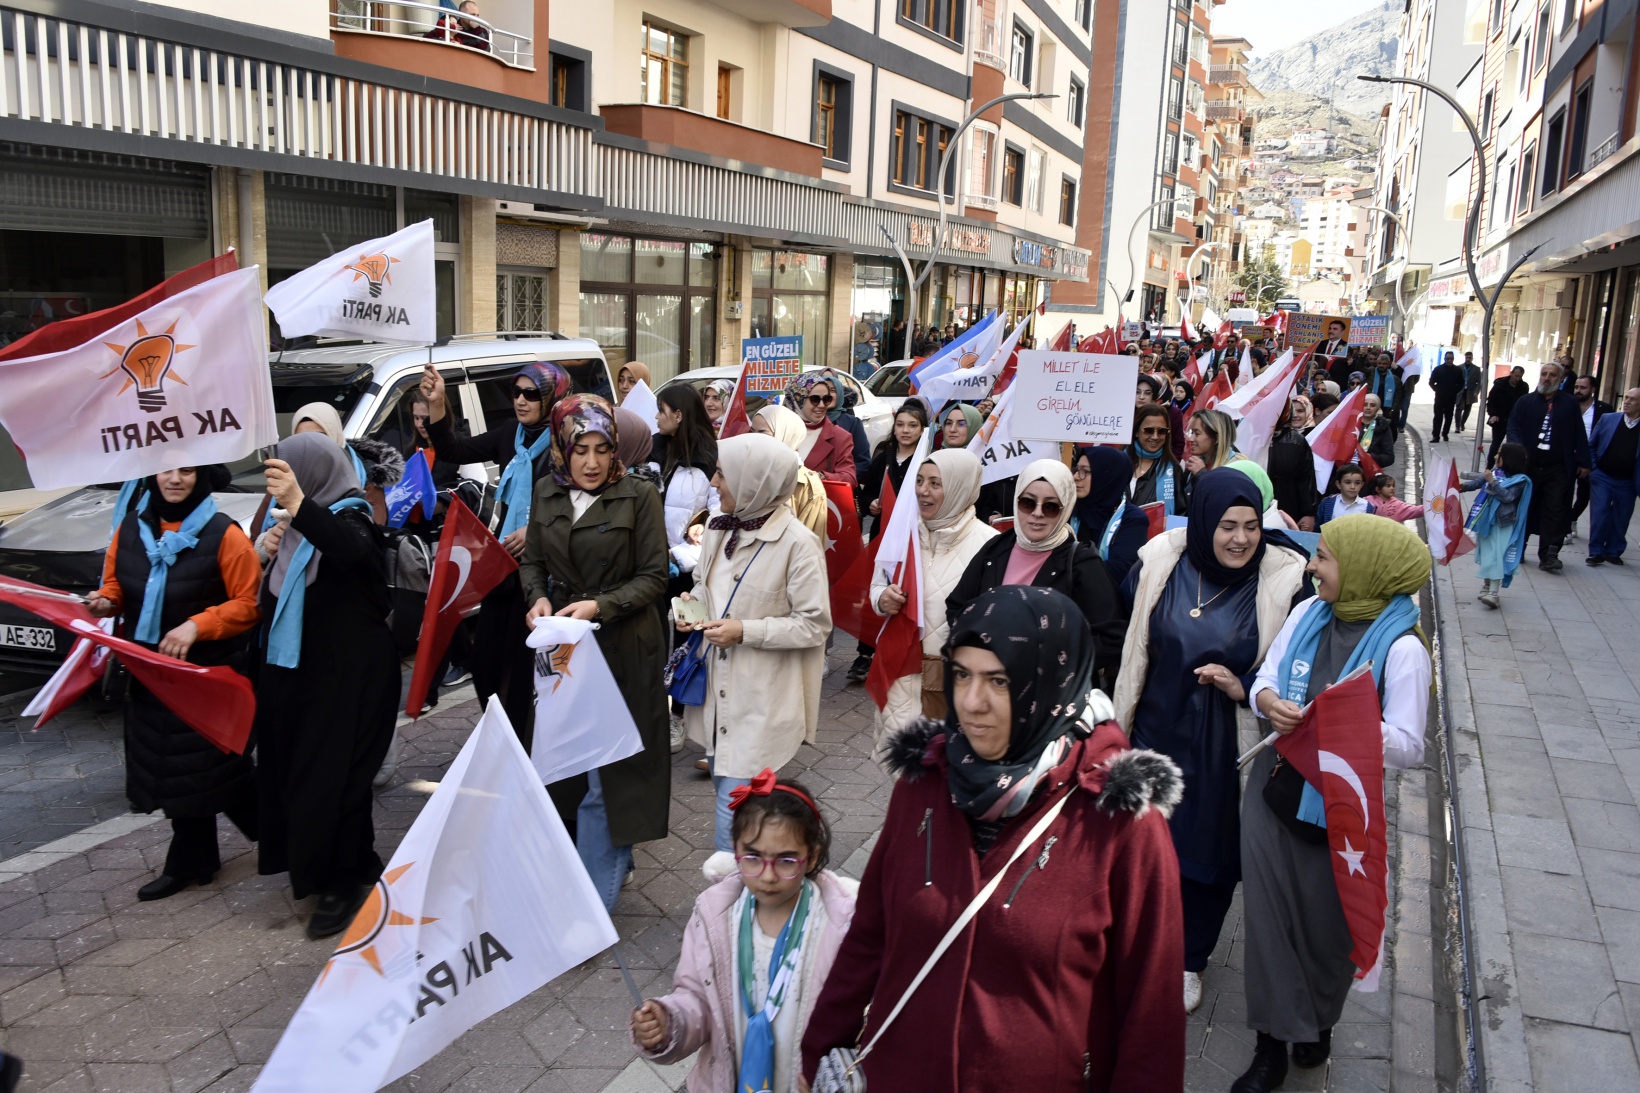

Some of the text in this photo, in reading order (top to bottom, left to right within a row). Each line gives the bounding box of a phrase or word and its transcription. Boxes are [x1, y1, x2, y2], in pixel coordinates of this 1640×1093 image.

[746, 340, 799, 358] EN GÜZELİ
[745, 358, 800, 376] MİLLETE
[1043, 359, 1101, 374] MİLLET İLE
[747, 374, 789, 392] HİZME
[1037, 396, 1082, 413] GİRELİM
[1066, 413, 1122, 430] GÖNÜLLERE
[6, 626, 54, 649] AE 332
